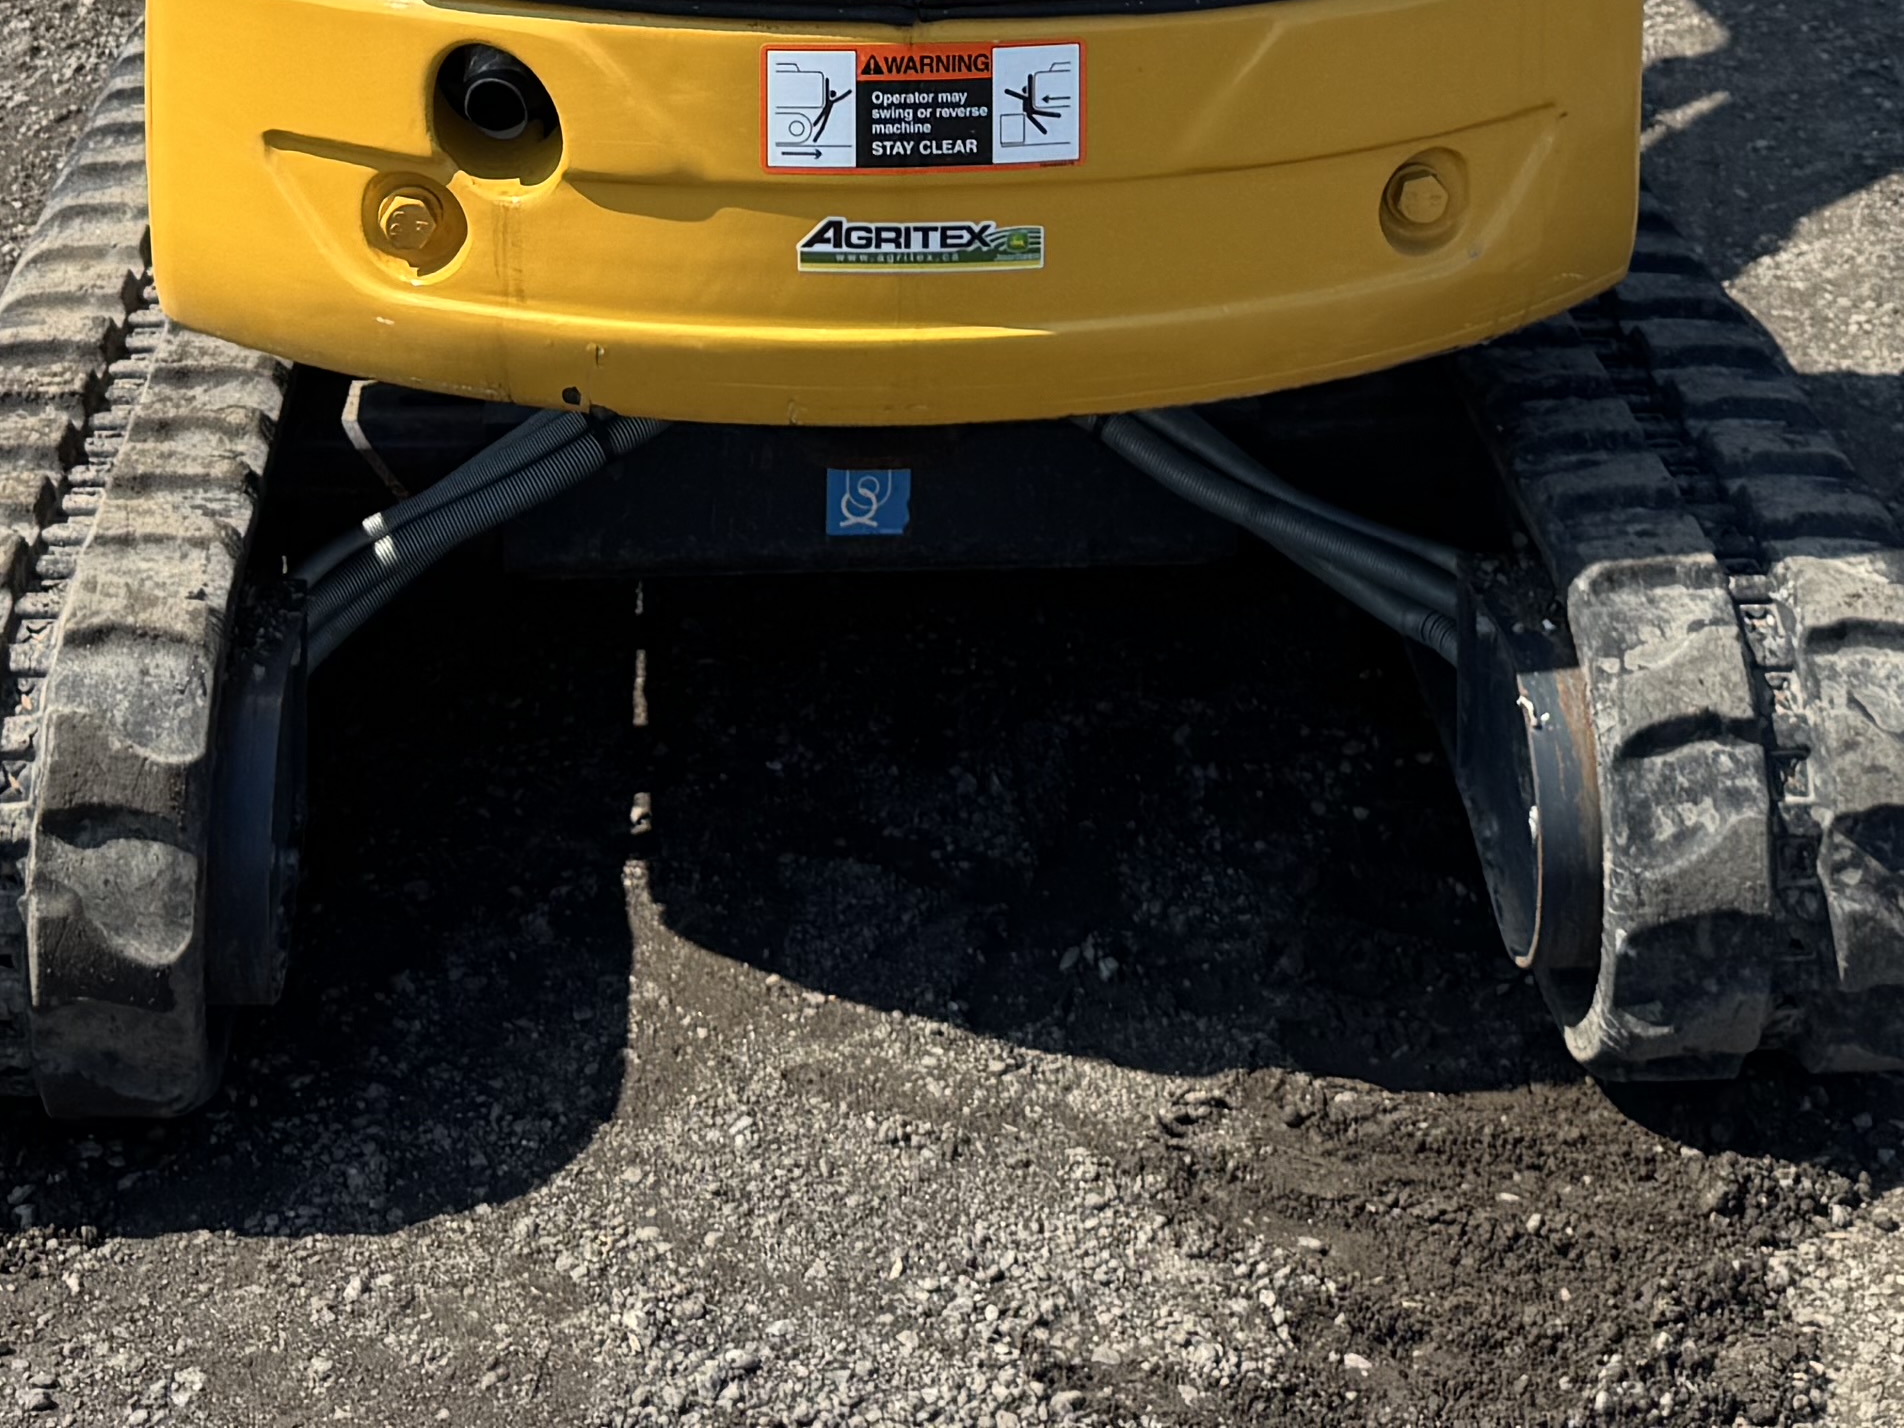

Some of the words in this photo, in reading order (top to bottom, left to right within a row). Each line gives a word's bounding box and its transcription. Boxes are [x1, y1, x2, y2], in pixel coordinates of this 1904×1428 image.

[883, 54, 990, 75] WARNING
[871, 90, 935, 106] Operator
[937, 91, 968, 104] may
[871, 107, 914, 121] swing
[917, 108, 932, 118] or
[935, 105, 989, 118] reverse
[871, 121, 932, 135] machine
[871, 140, 915, 156] STAY
[918, 139, 978, 155] CLEAR
[801, 219, 993, 250] AGRITEX
[835, 252, 960, 263] www.agritex.ca
